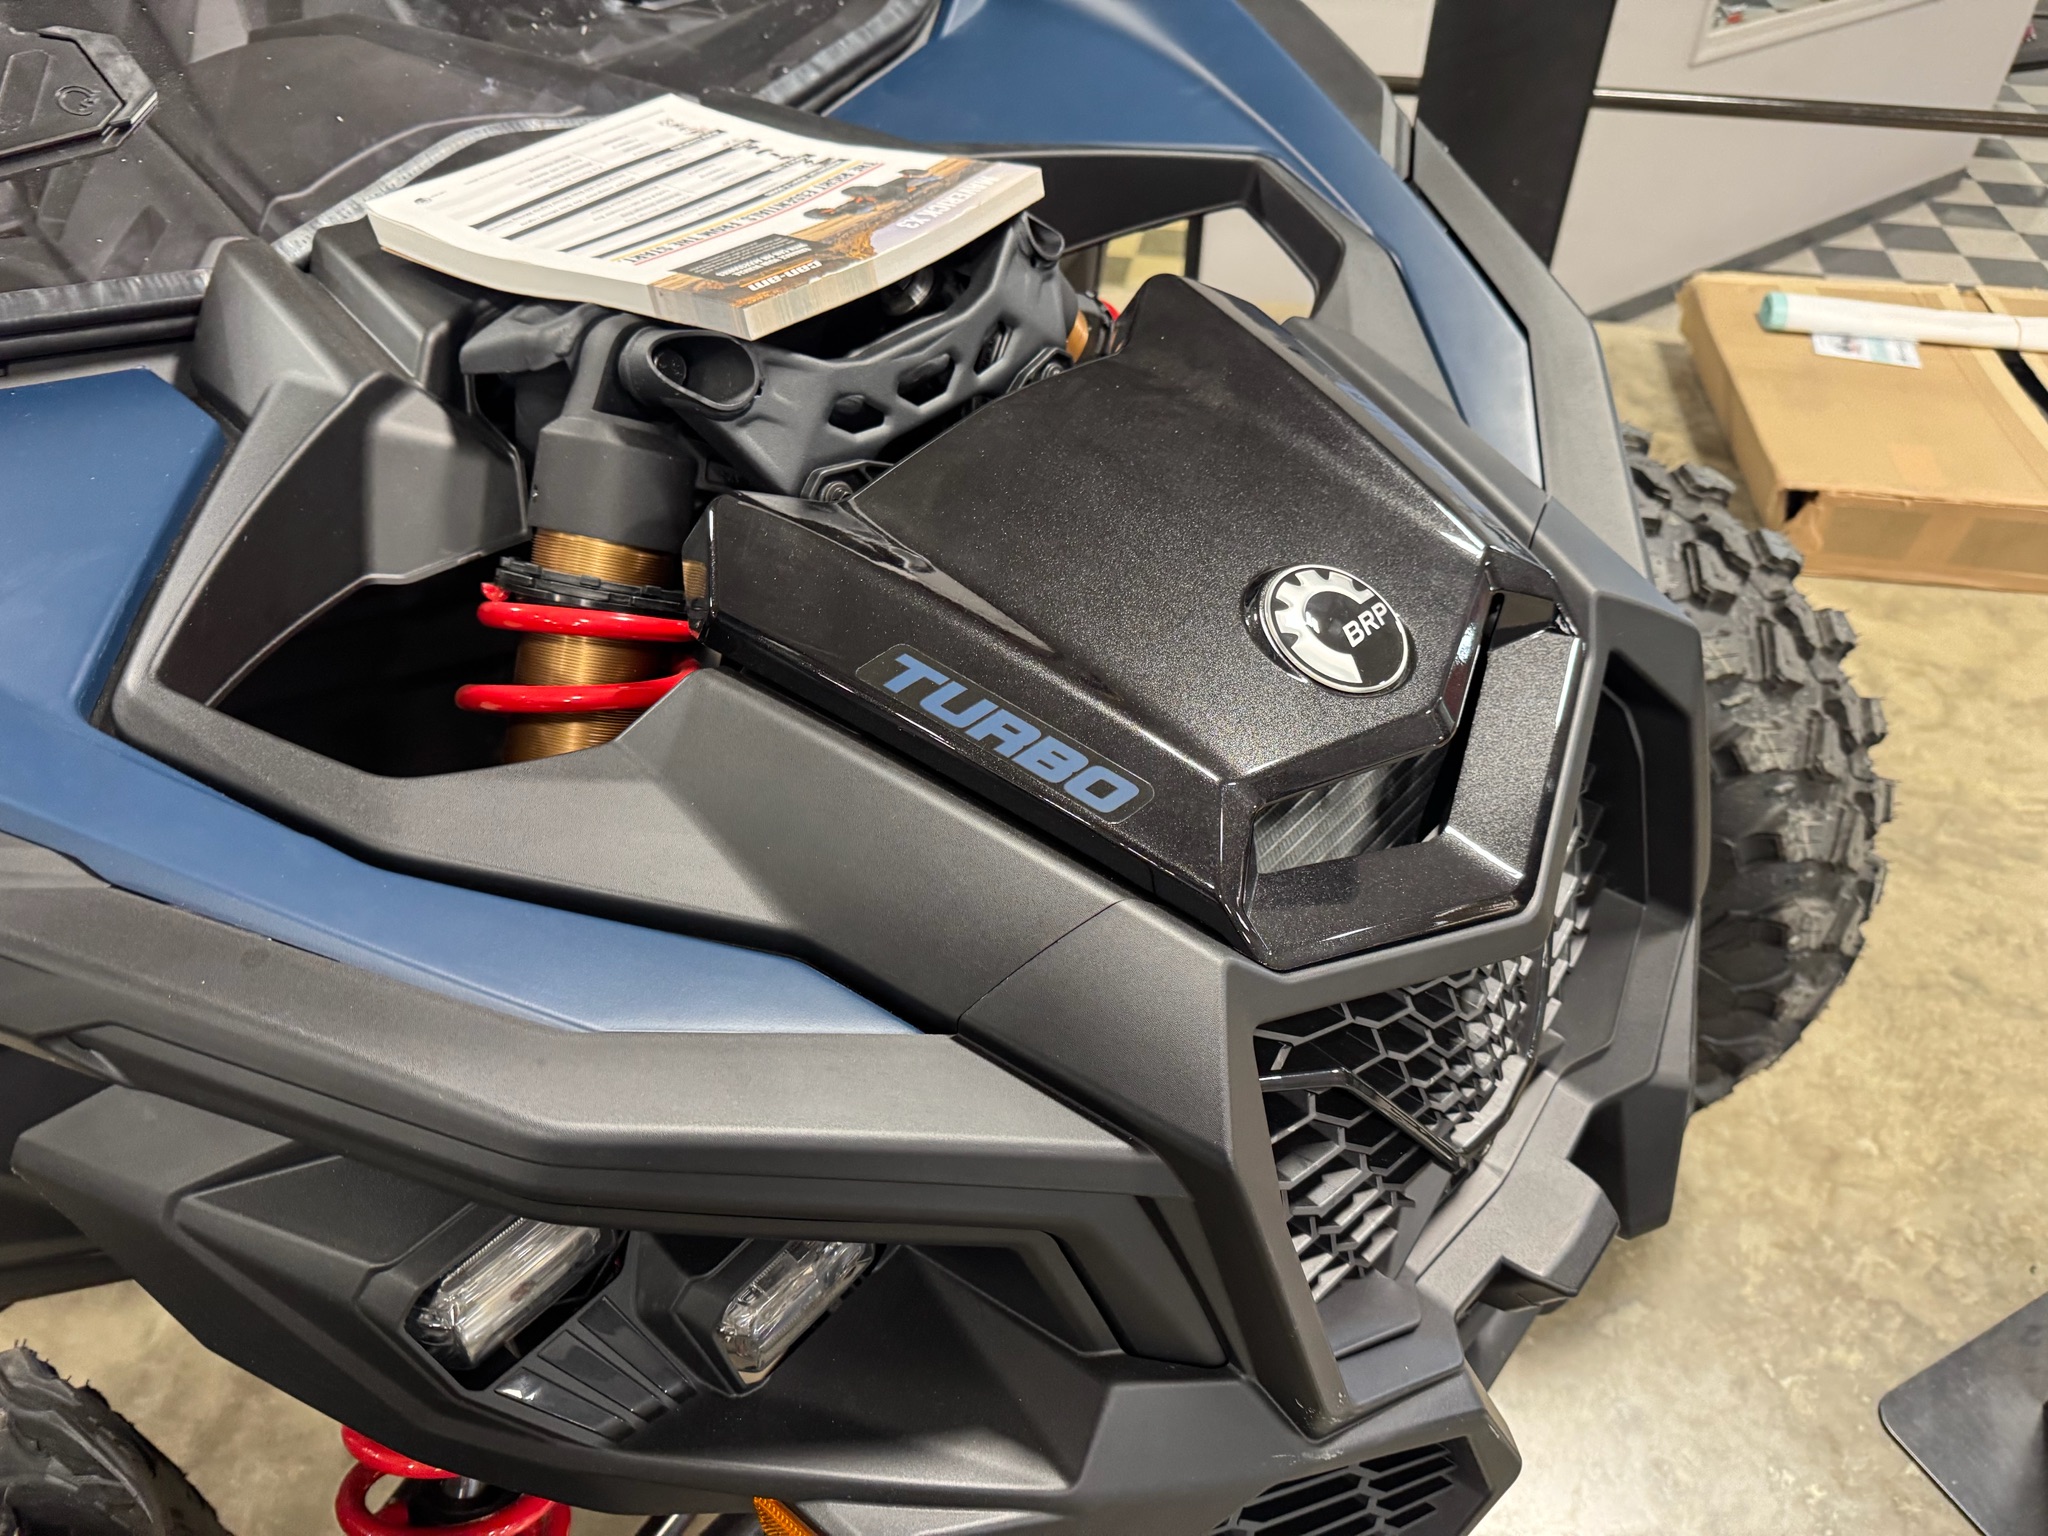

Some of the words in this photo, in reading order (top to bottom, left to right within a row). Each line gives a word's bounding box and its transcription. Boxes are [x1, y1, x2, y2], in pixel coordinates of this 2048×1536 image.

[922, 174, 1001, 218] MAVERICK
[896, 211, 932, 229] X3
[747, 260, 823, 292] can-am
[1342, 601, 1388, 648] BRP
[882, 653, 1140, 813] TURBO
